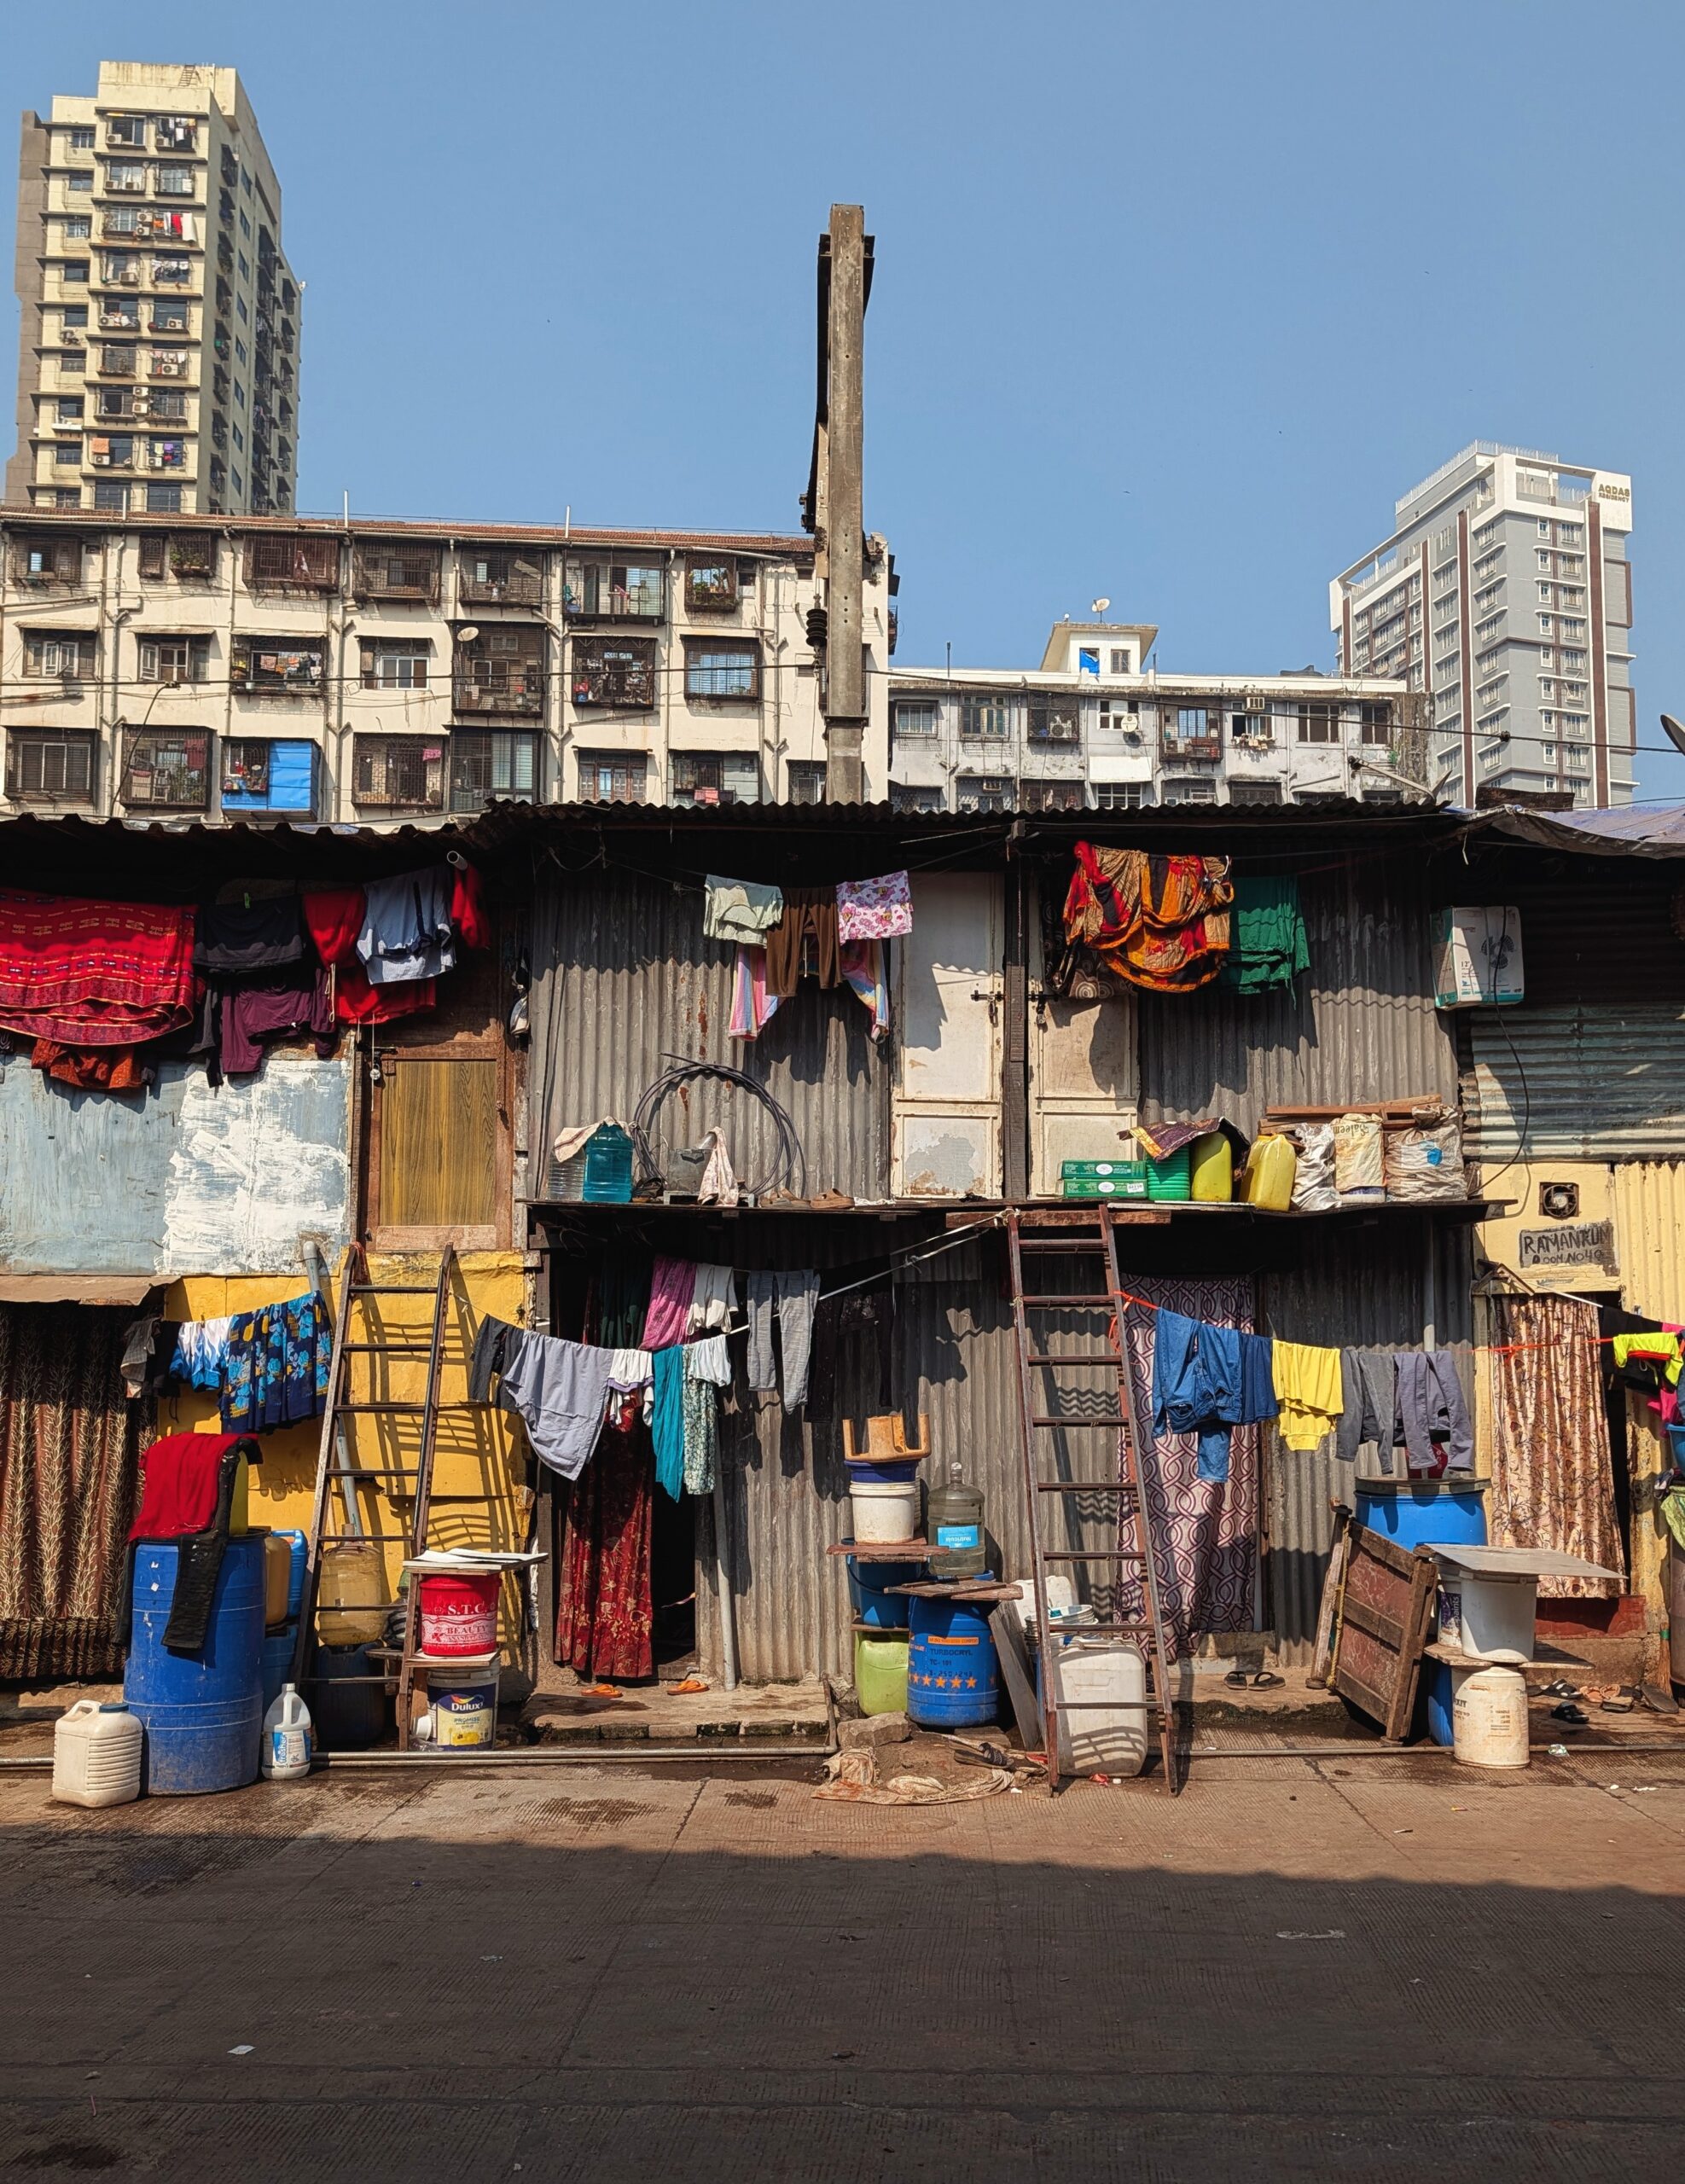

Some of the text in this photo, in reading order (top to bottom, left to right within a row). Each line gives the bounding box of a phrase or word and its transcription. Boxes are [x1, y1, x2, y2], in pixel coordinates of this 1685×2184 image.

[1598, 484, 1630, 497] AQDAS
[447, 1624, 486, 1635] BEAUTY
[451, 1703, 480, 1711] Dulux
